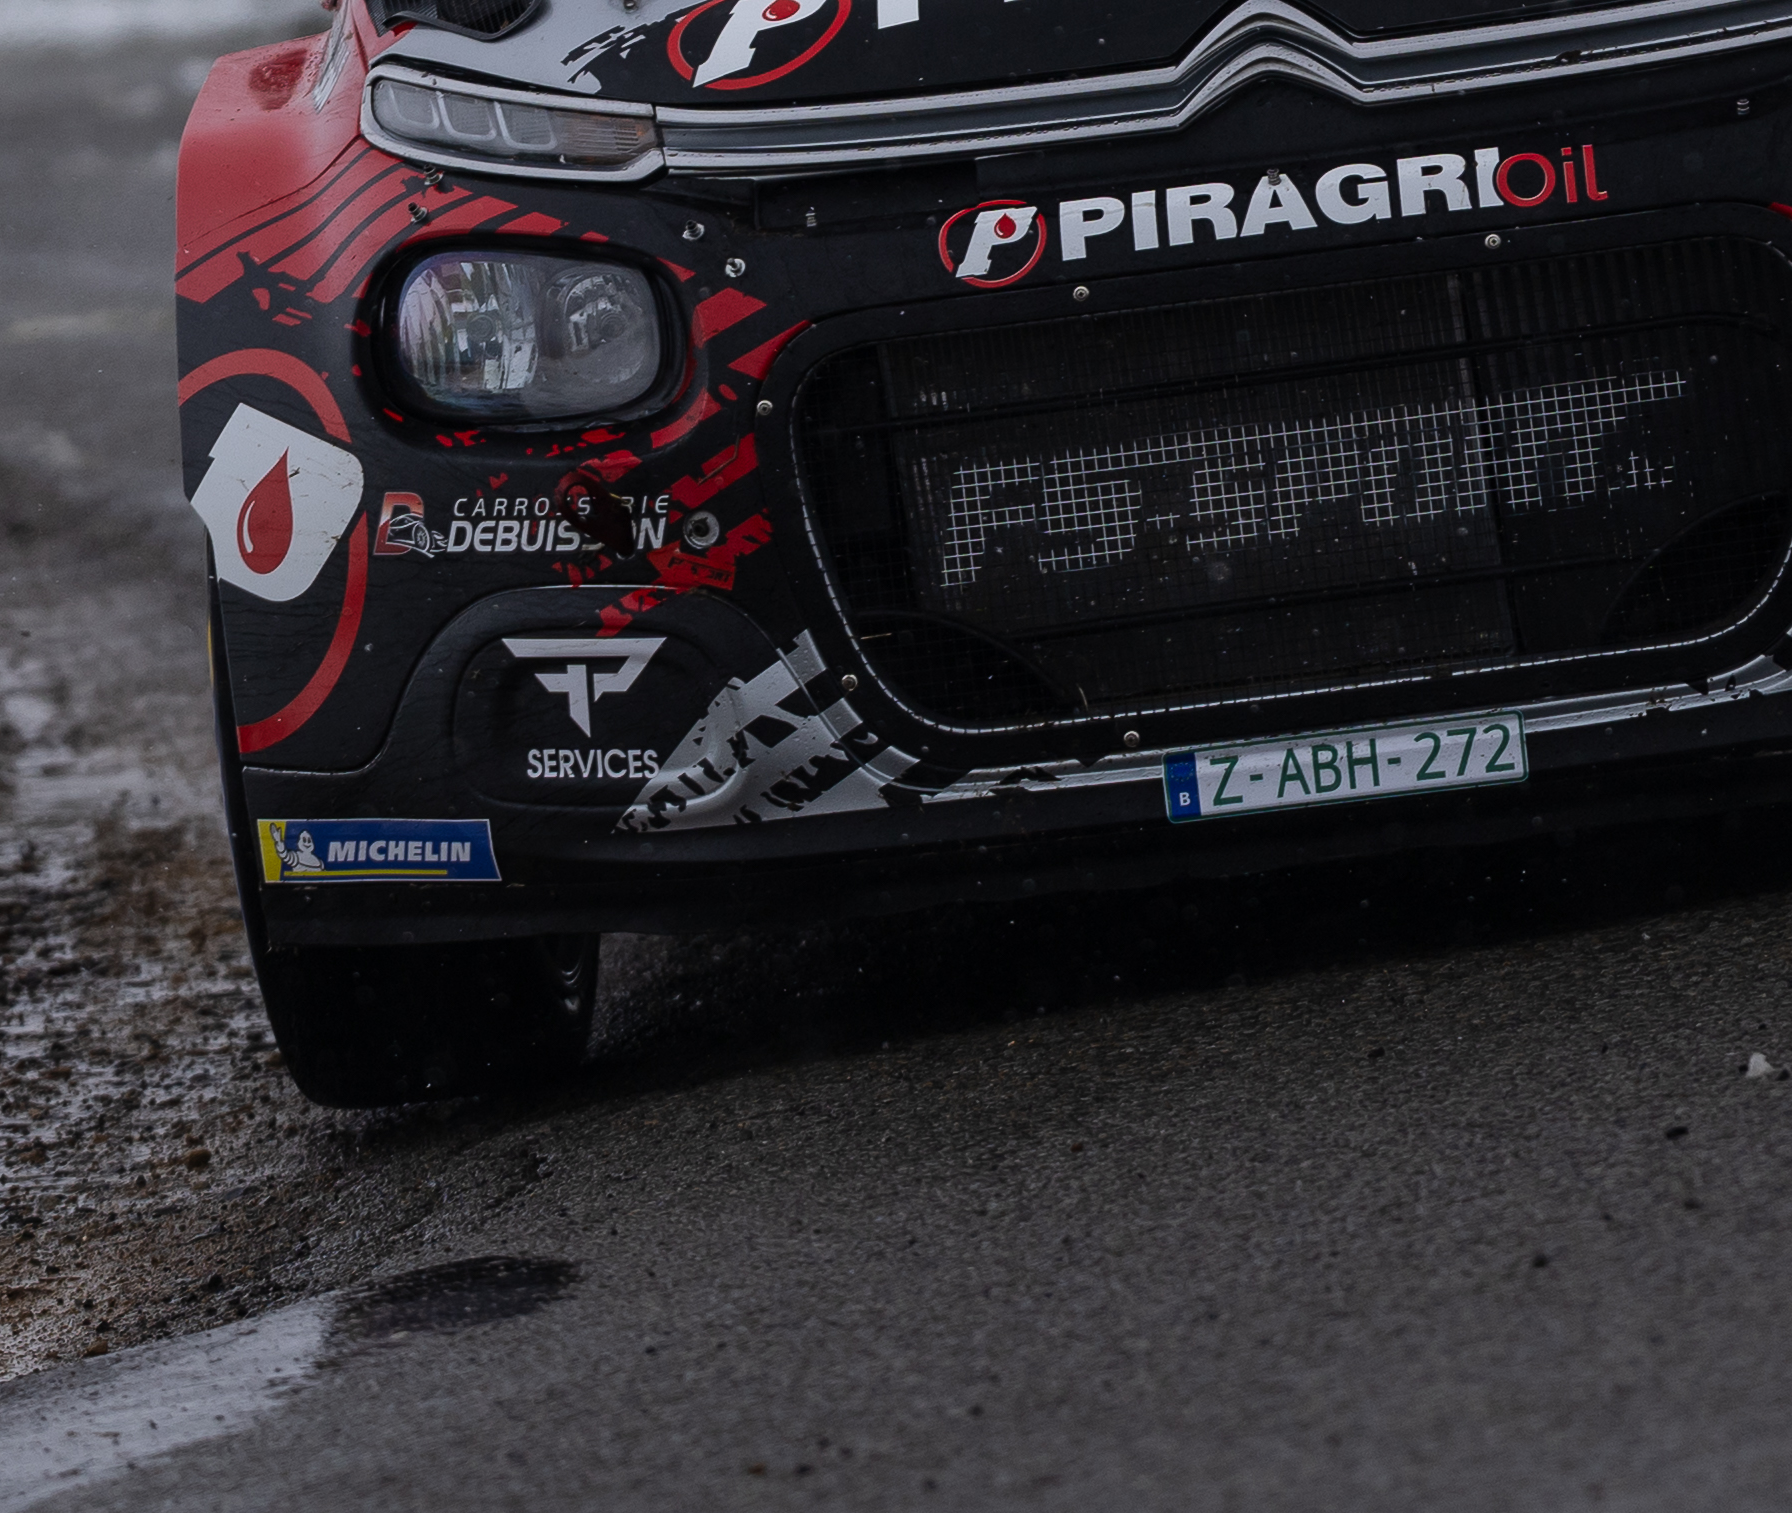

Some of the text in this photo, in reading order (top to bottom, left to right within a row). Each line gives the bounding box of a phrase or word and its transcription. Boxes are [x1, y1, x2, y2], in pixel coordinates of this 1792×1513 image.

[453, 494, 670, 516] CARROSRIE
[447, 518, 667, 552] DEBUISN
[527, 748, 659, 779] SERVICES
[1179, 723, 1516, 807] B Z-ABH-272
[327, 840, 472, 862] MICHELIN
